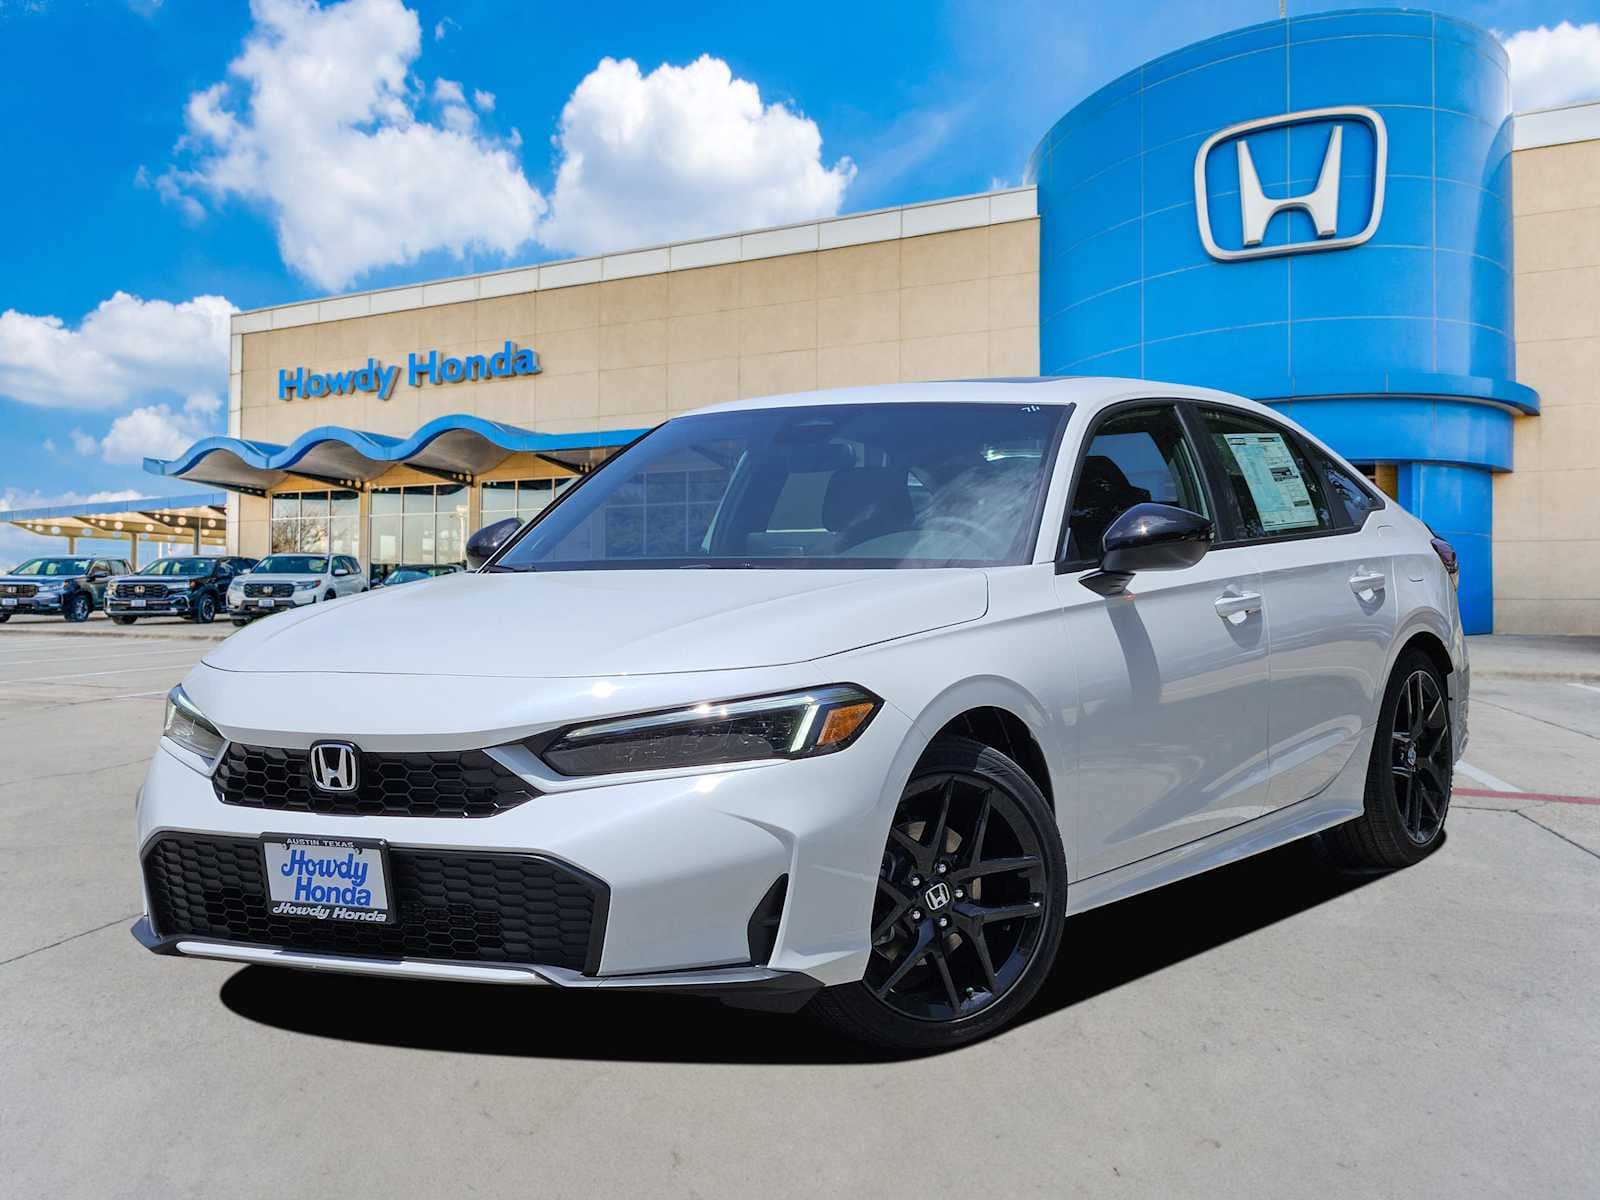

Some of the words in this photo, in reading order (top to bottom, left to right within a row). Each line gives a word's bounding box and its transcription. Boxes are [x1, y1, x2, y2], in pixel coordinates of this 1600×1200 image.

[278, 358, 401, 400] Howdy
[408, 340, 541, 387] Honda
[286, 838, 320, 846] AUSTIN
[324, 840, 355, 848] TEXAS
[281, 849, 368, 887] Howdy
[294, 876, 372, 906] Honda
[272, 902, 330, 920] Howdy
[332, 907, 387, 922] Honda
